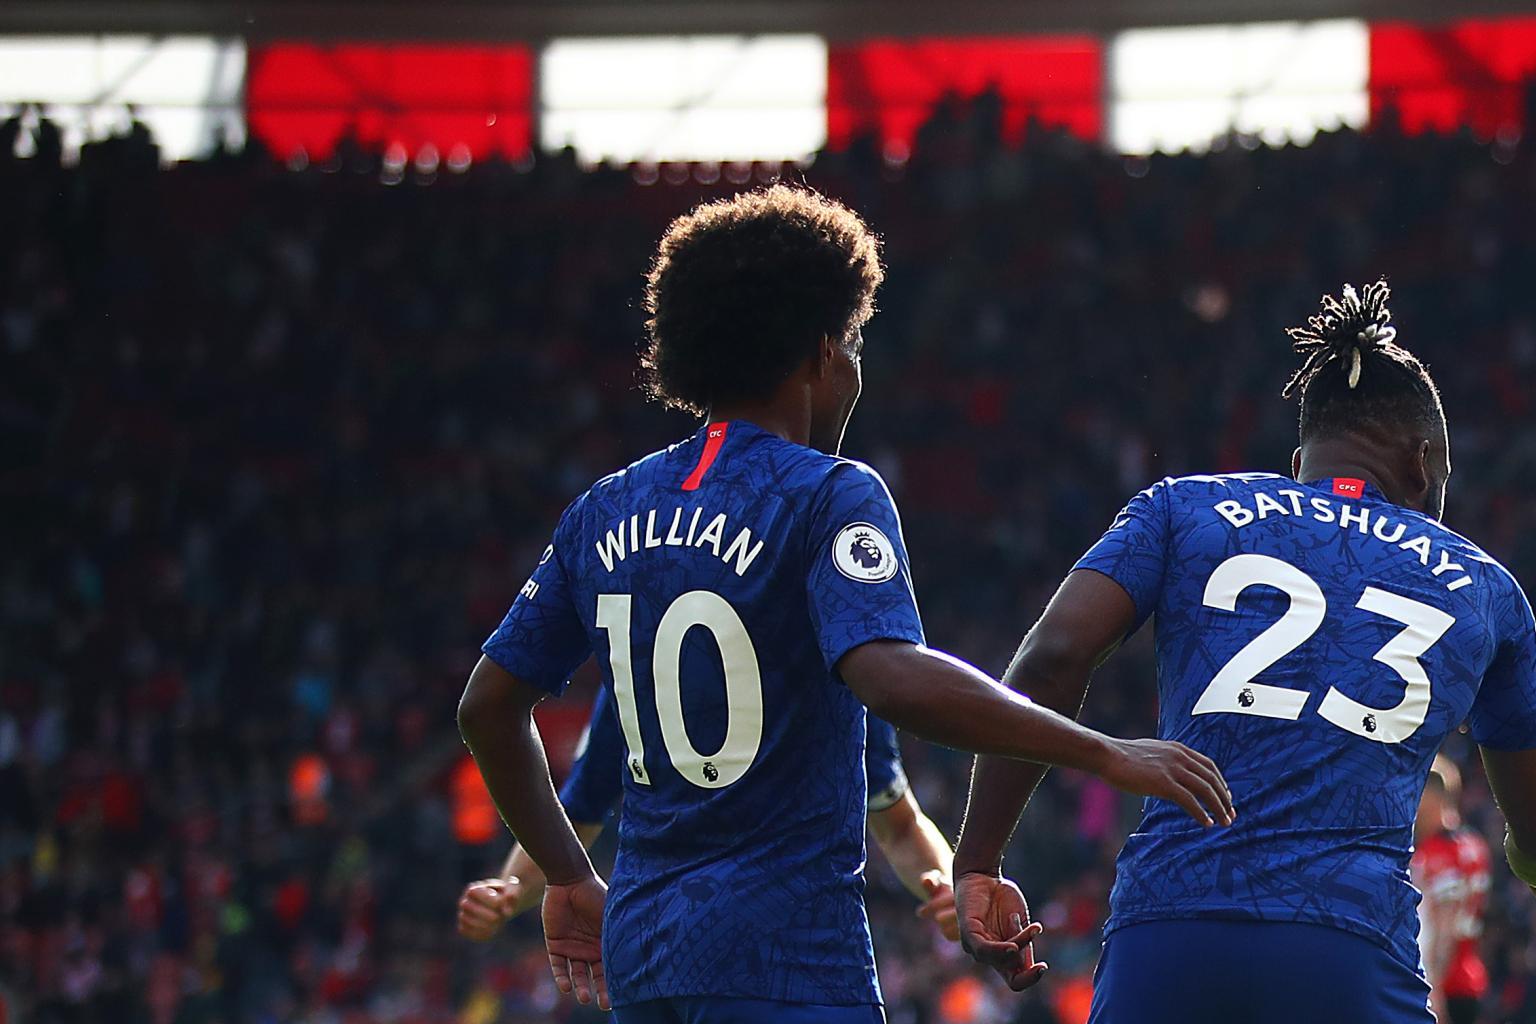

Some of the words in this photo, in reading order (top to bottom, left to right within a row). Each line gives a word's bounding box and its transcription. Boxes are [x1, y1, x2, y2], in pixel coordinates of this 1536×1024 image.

[1339, 484, 1357, 492] CFC
[595, 507, 764, 576] WILLIAN
[1213, 489, 1473, 592] BATSHUAYI
[595, 590, 763, 789] 10
[1191, 554, 1456, 744] 23
